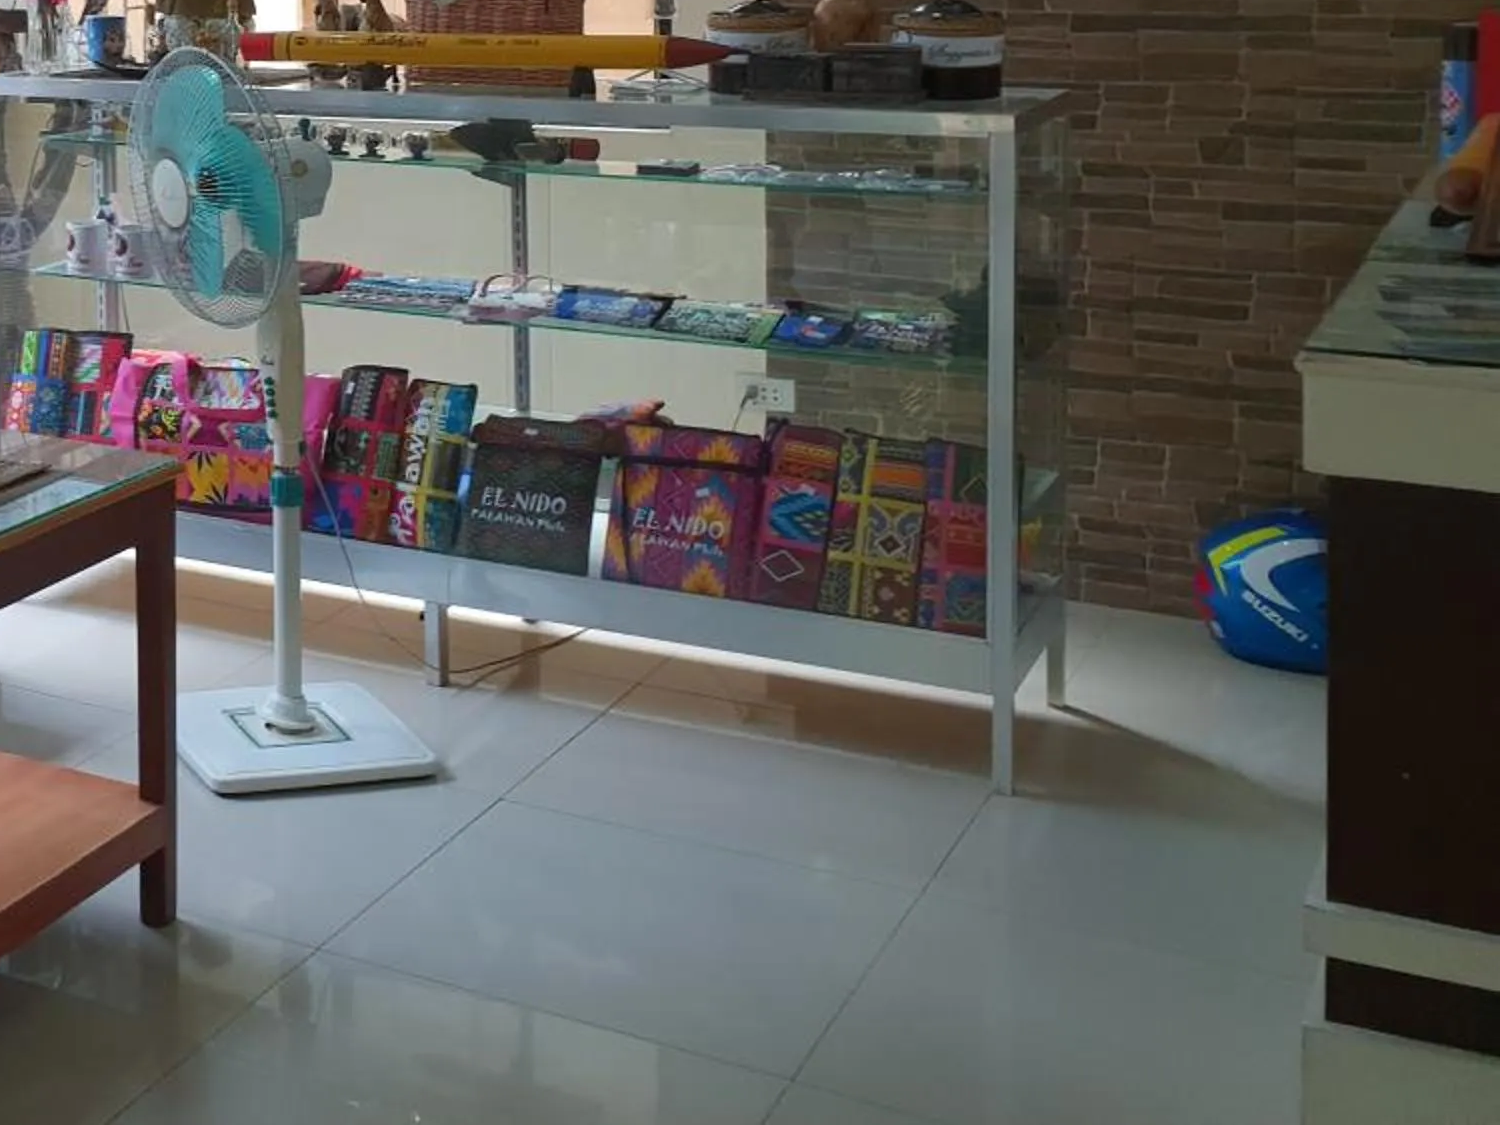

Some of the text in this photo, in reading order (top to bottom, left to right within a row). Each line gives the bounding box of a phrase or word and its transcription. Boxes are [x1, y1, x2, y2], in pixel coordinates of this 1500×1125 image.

[481, 486, 567, 515] EL NIDO
[633, 506, 725, 539] EL NIDO
[1241, 589, 1309, 643] SUZUKI
